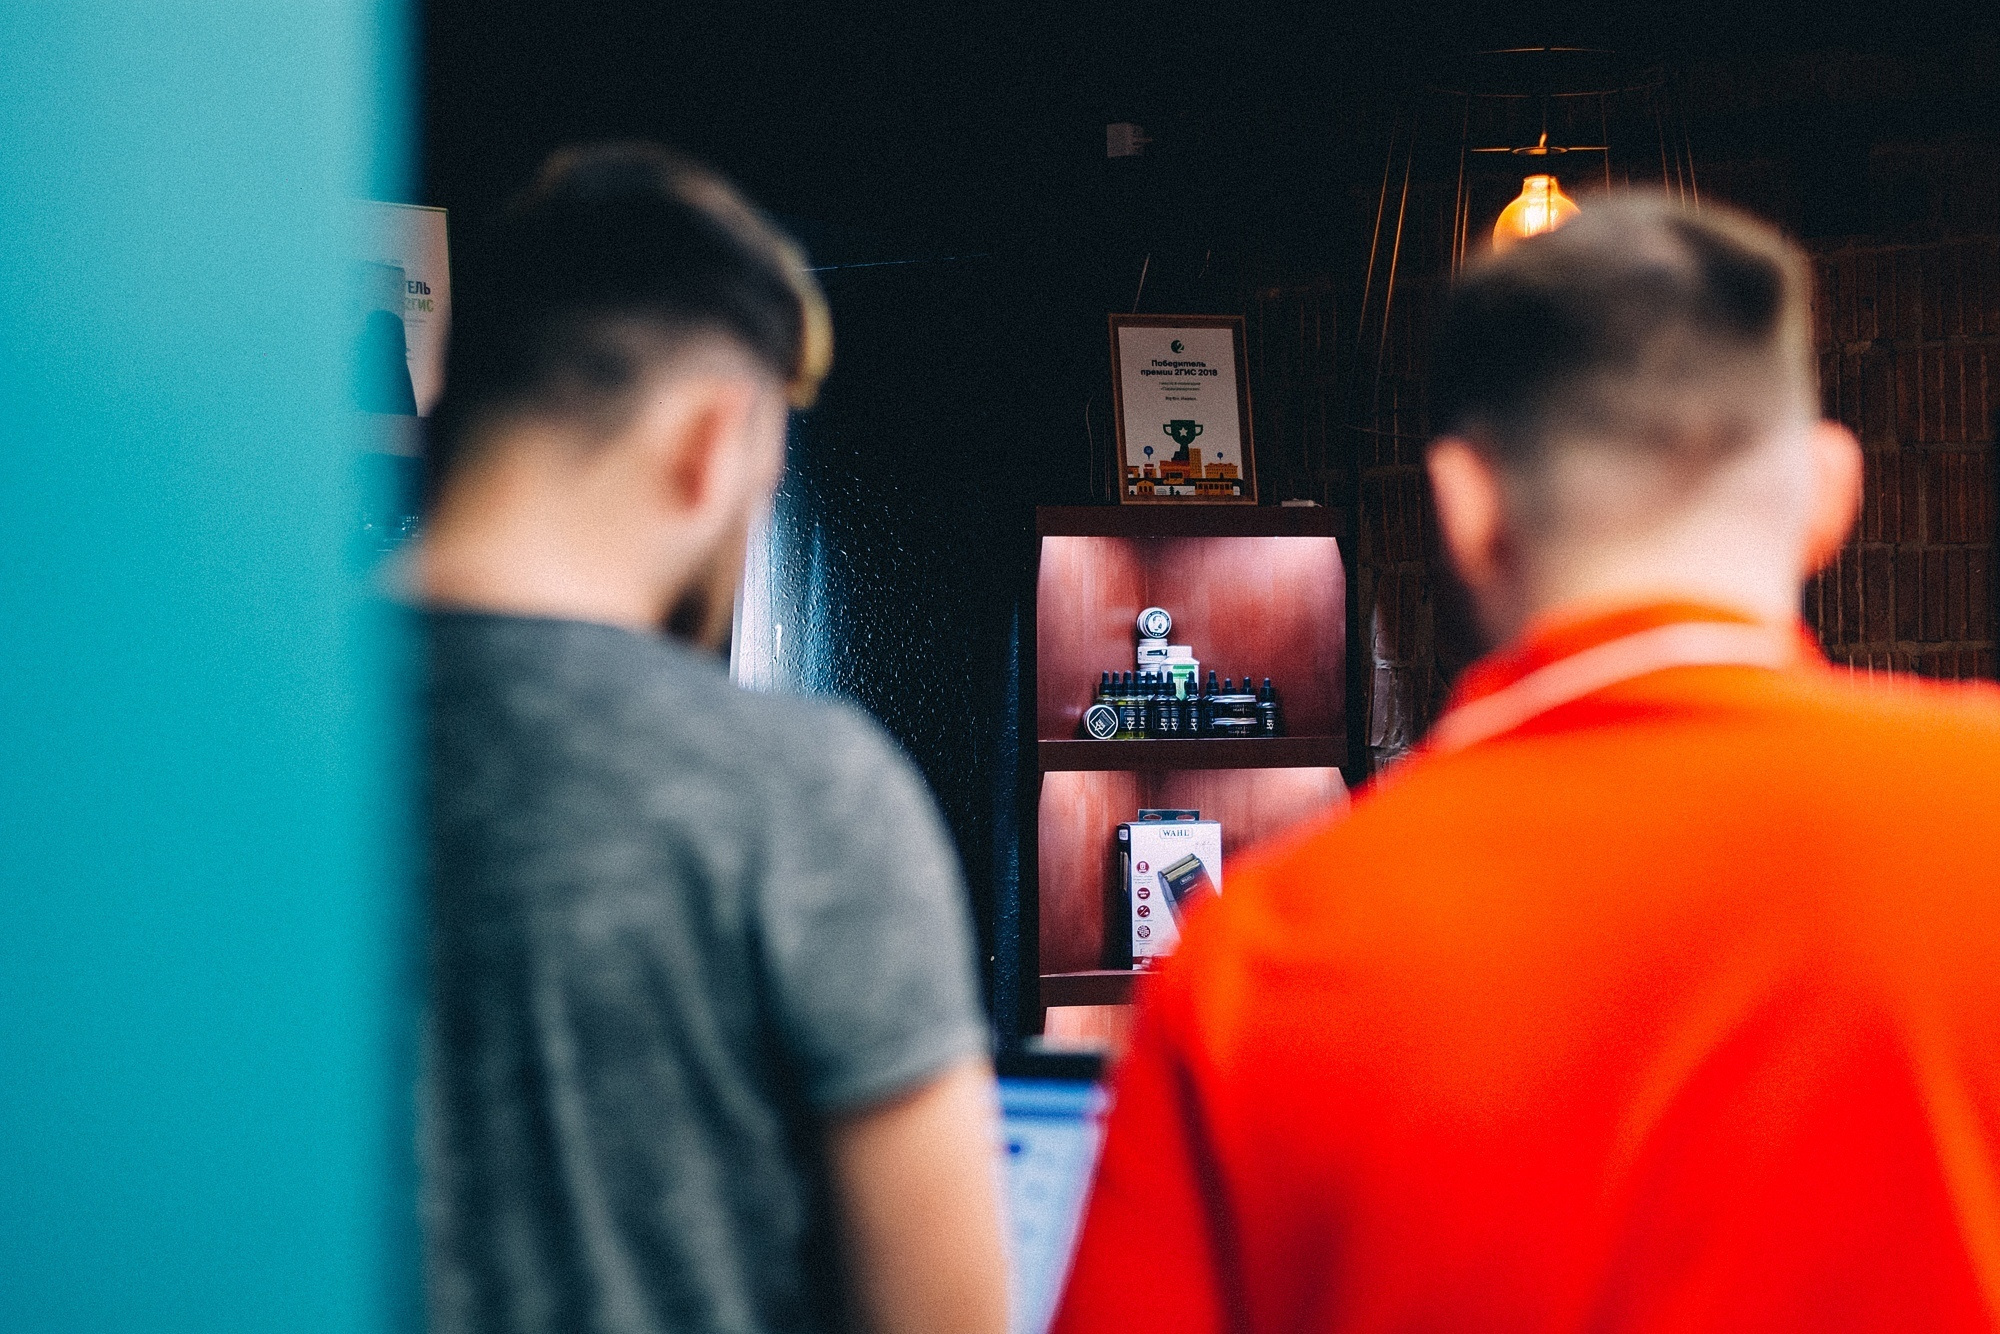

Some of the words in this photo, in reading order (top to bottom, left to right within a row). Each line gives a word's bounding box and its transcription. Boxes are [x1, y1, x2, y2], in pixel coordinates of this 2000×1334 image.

[1151, 359, 1206, 368] Победитель
[1174, 368, 1197, 376] 2ГИС
[1198, 368, 1218, 376] 2018
[1162, 829, 1190, 837] WAHL
